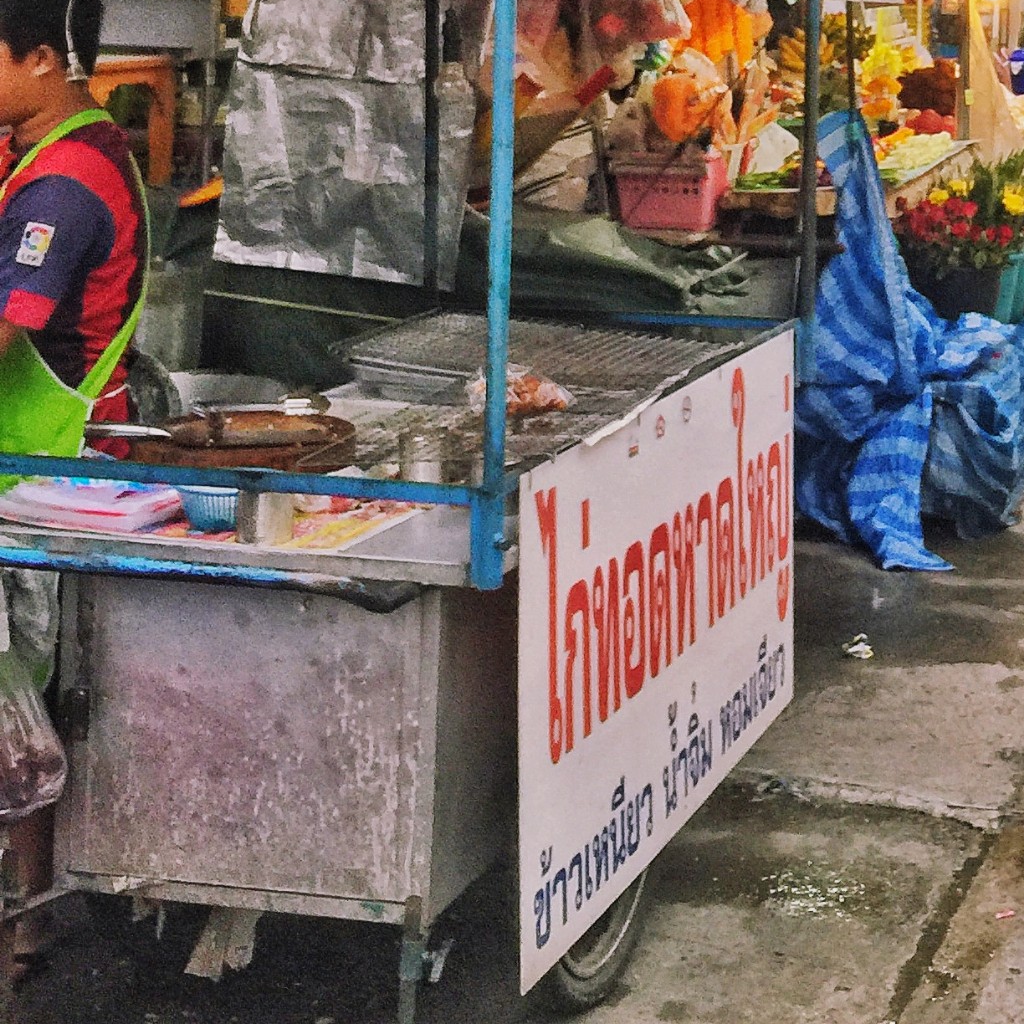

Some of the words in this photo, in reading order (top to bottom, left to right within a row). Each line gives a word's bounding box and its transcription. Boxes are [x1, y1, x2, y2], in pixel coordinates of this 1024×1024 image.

[534, 367, 791, 764] ไก่ทอดหาดใหญ่
[533, 775, 653, 950] ข้าวเหนียว
